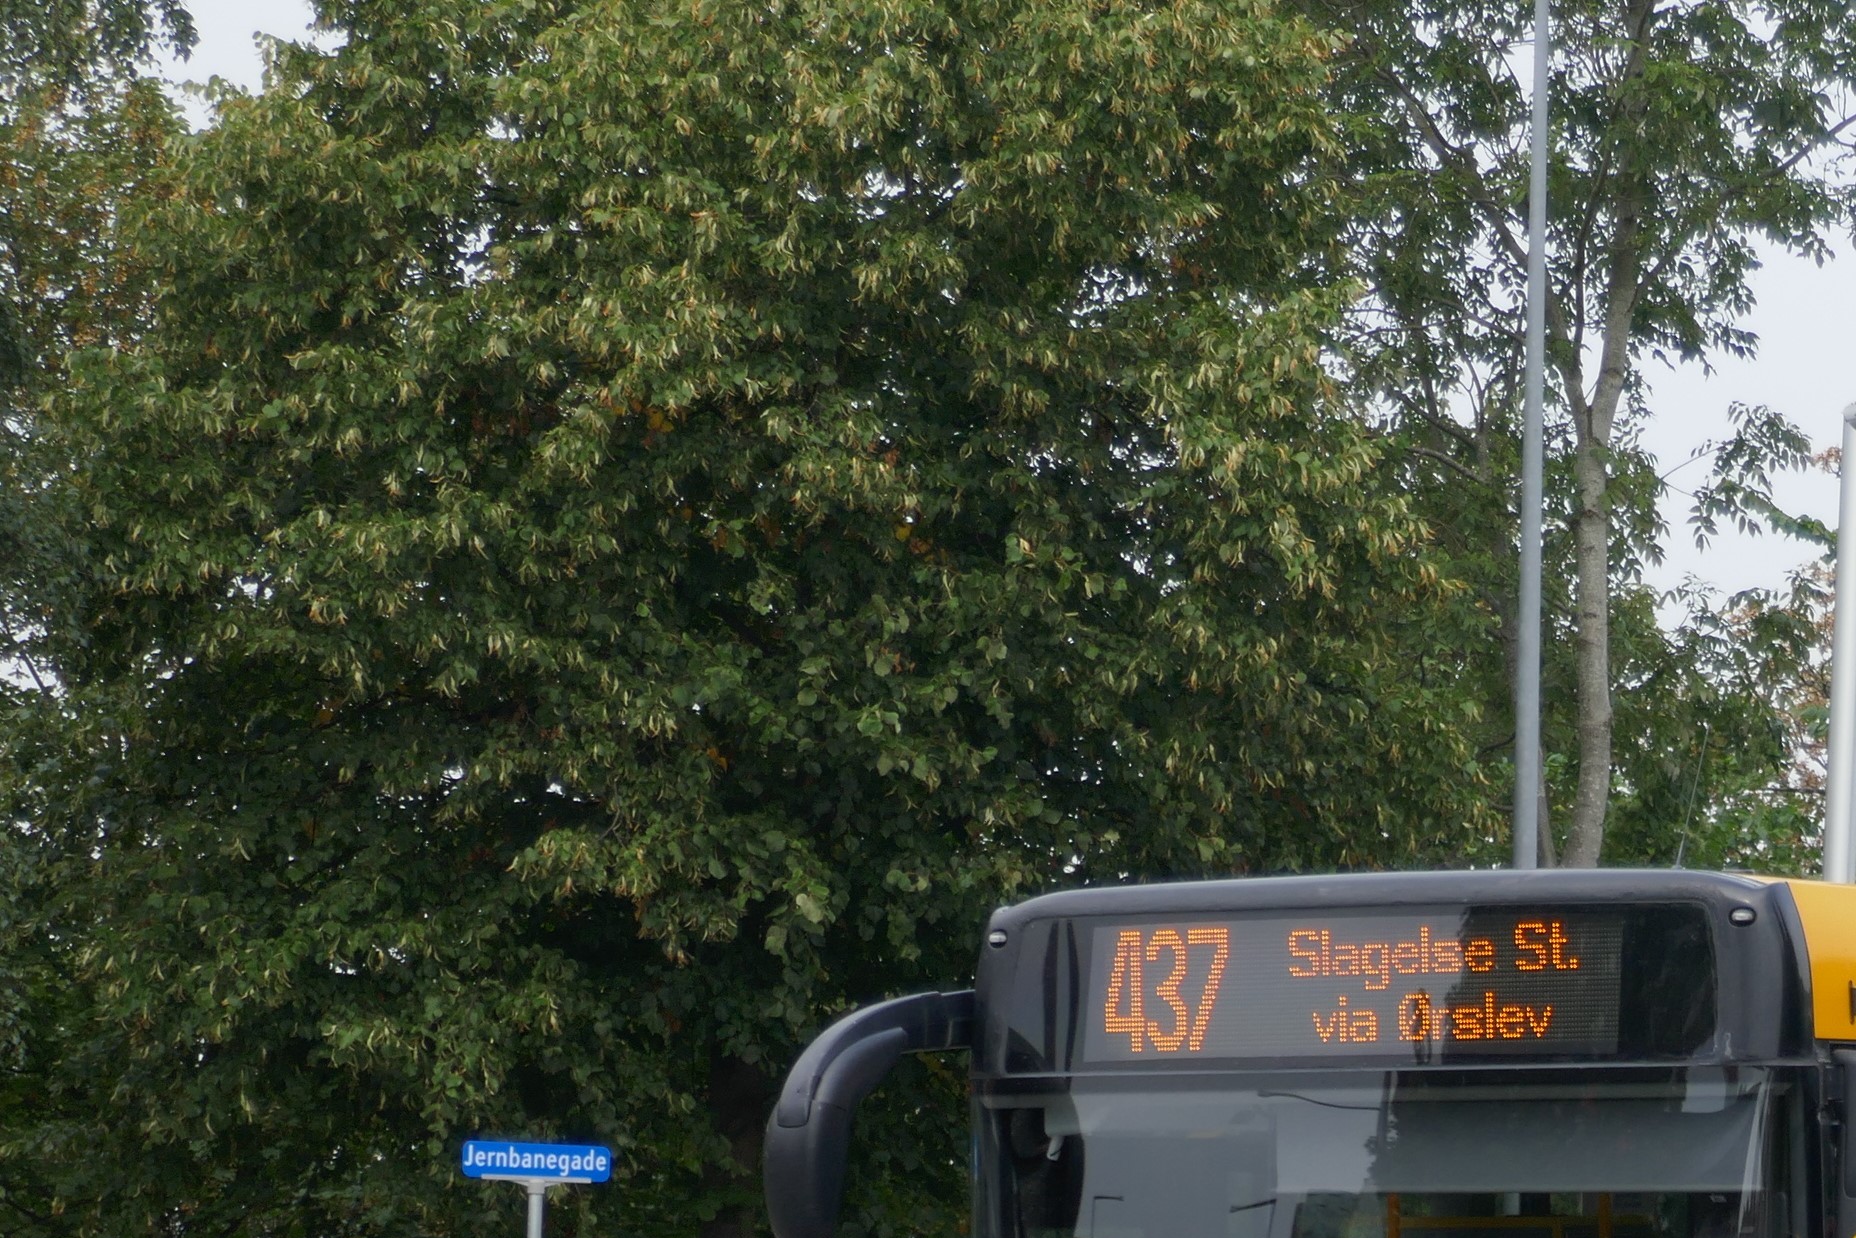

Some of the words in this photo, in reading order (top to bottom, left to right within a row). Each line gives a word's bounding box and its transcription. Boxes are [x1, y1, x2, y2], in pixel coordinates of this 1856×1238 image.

[1104, 927, 1229, 1053] 437
[1288, 926, 1495, 990] Slagelse
[1515, 922, 1580, 971] St.
[1313, 996, 1377, 1042] via
[1399, 991, 1552, 1041] Ørslev
[464, 1144, 607, 1176] Jernbanegade
